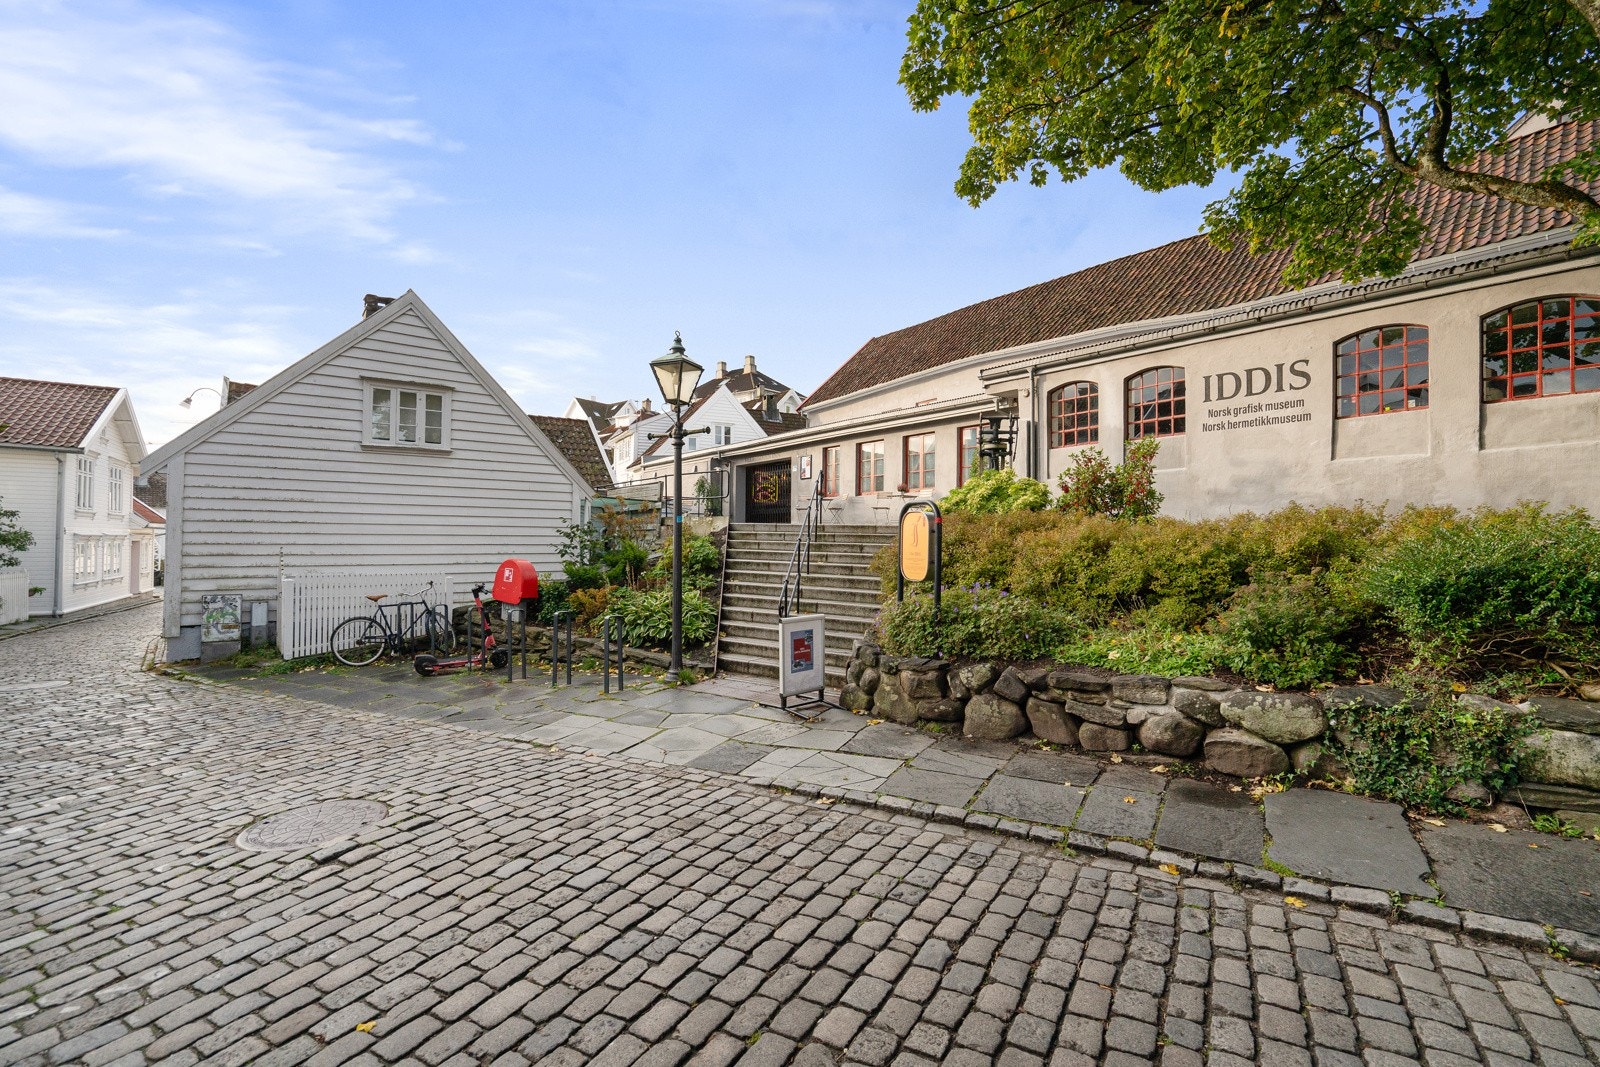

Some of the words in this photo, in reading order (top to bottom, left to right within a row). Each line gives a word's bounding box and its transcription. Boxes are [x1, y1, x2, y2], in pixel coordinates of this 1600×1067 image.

[1203, 359, 1312, 403] IDDIS
[1208, 406, 1232, 418] Norsk
[1233, 402, 1263, 417] grafisk
[1265, 398, 1305, 412] museum
[1202, 421, 1226, 432] Norsk
[1227, 412, 1312, 429] hermetikkmuseum
